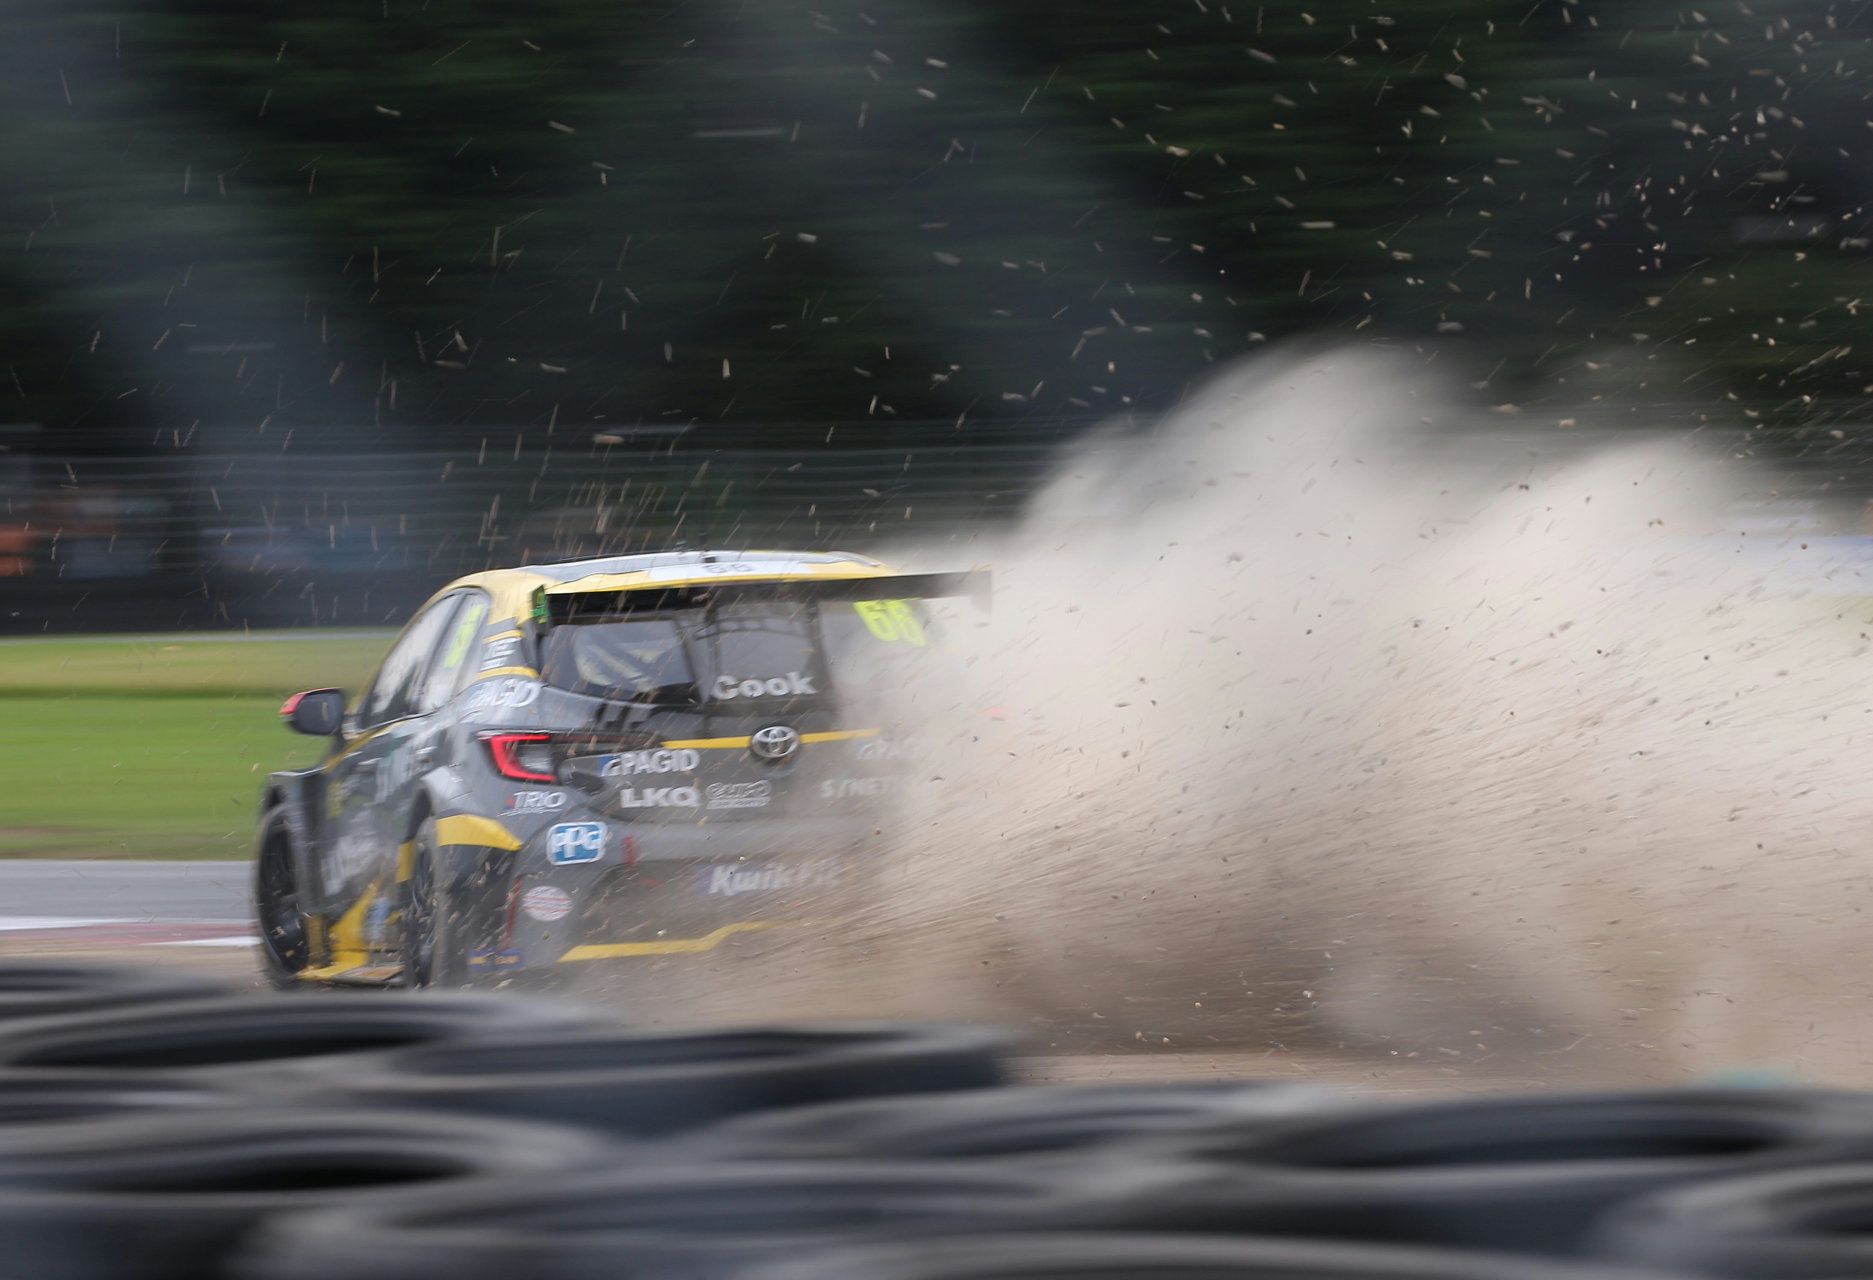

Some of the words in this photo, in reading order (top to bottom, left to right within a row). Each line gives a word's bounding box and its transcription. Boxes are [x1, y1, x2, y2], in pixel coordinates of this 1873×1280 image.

[713, 672, 817, 701] Cook
[620, 749, 701, 775] PAGID
[513, 791, 568, 809] TRIO
[620, 785, 701, 809] LKQ
[550, 826, 604, 858] PPG
